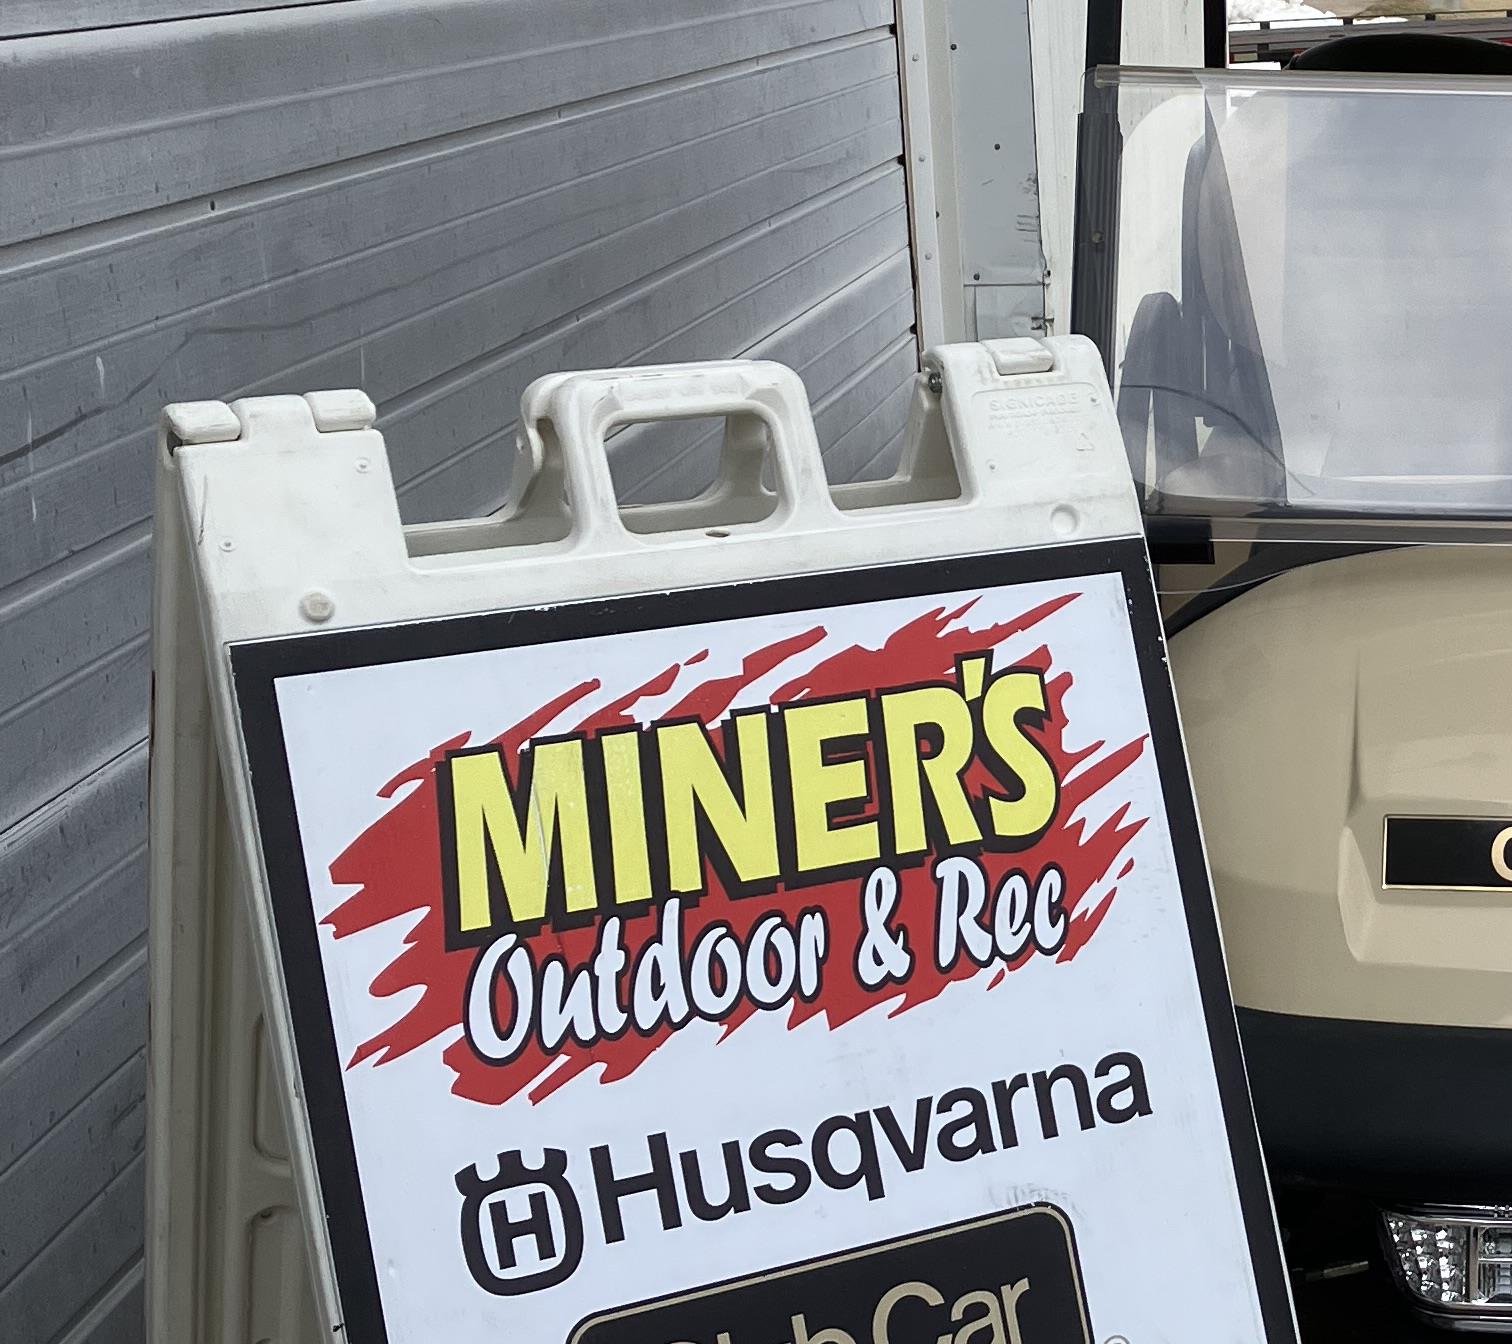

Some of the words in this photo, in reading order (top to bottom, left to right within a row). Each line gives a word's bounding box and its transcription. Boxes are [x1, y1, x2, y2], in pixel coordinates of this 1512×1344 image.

[445, 653, 1060, 940] MINER'S
[466, 897, 826, 1061] Outdoor
[856, 865, 914, 989] &
[933, 855, 1070, 970] Rec
[591, 1051, 1152, 1244] Husqvarna
